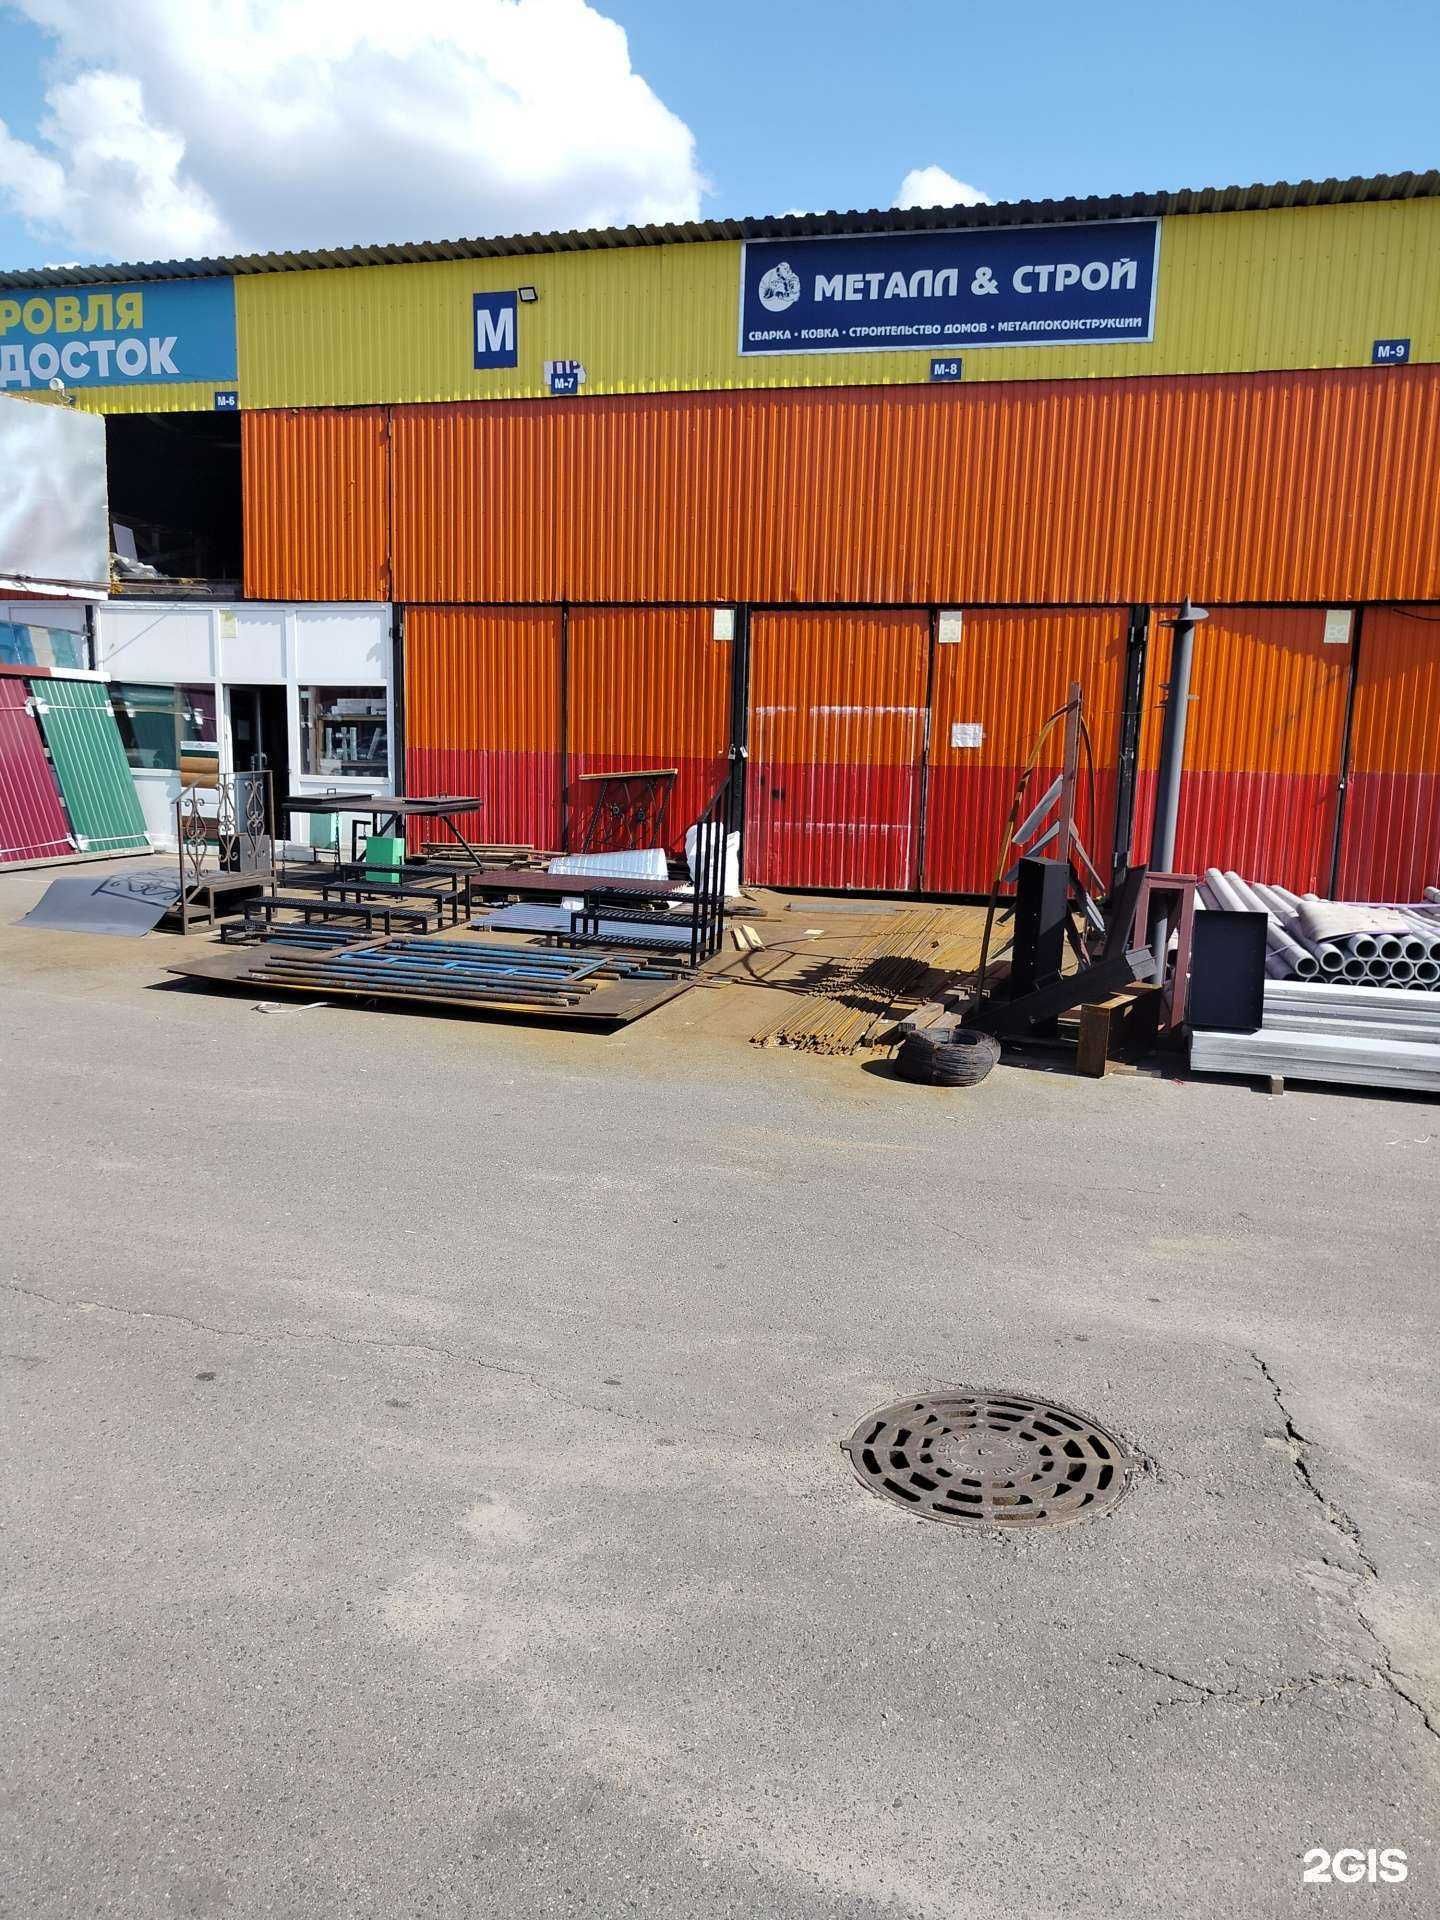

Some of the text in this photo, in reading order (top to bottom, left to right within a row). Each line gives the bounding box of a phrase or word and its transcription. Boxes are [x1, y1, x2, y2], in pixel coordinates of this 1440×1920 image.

[814, 257, 1138, 302] МЕТАЛЛ & СТРОЙ
[477, 307, 514, 353] М
[748, 317, 1142, 342] СВАРКА КОВКА СТРОИТЕЛЬСТВО ДОМОВ МЕТАЛЛОКОНСТРУКЦИИ
[1377, 344, 1405, 358] М-9
[934, 363, 958, 375] М-8
[554, 377, 574, 389] М-7
[217, 395, 235, 406] М-6
